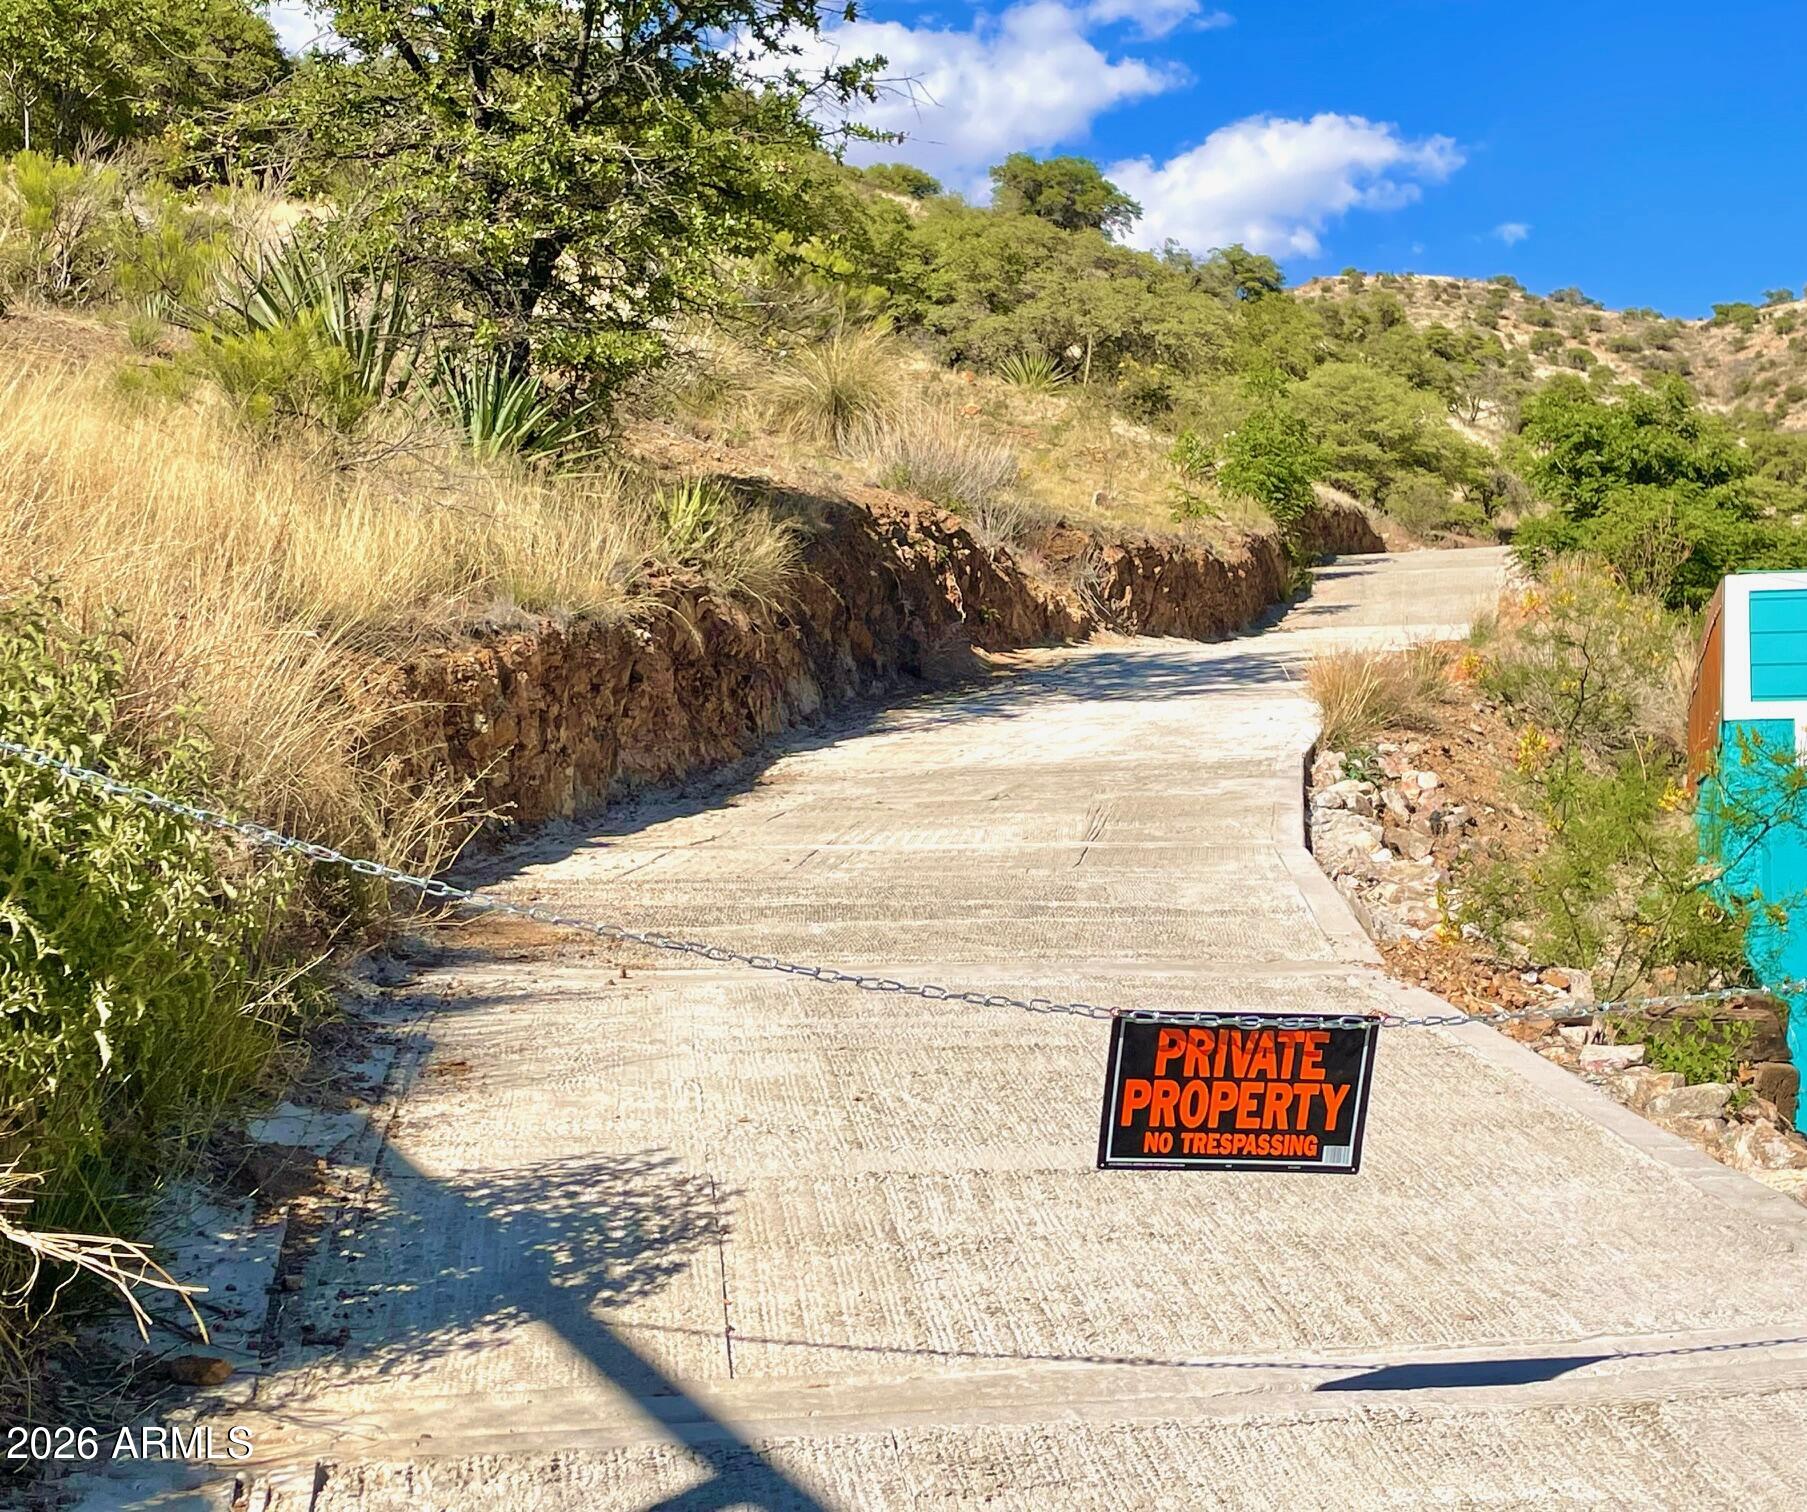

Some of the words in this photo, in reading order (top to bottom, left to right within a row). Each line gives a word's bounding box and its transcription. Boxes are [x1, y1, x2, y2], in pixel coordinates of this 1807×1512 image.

[1154, 1028, 1331, 1080] PRIVATE
[1120, 1078, 1351, 1131] PROPERTY
[1143, 1132, 1173, 1153] NO
[1182, 1132, 1318, 1156] TRESPASSING
